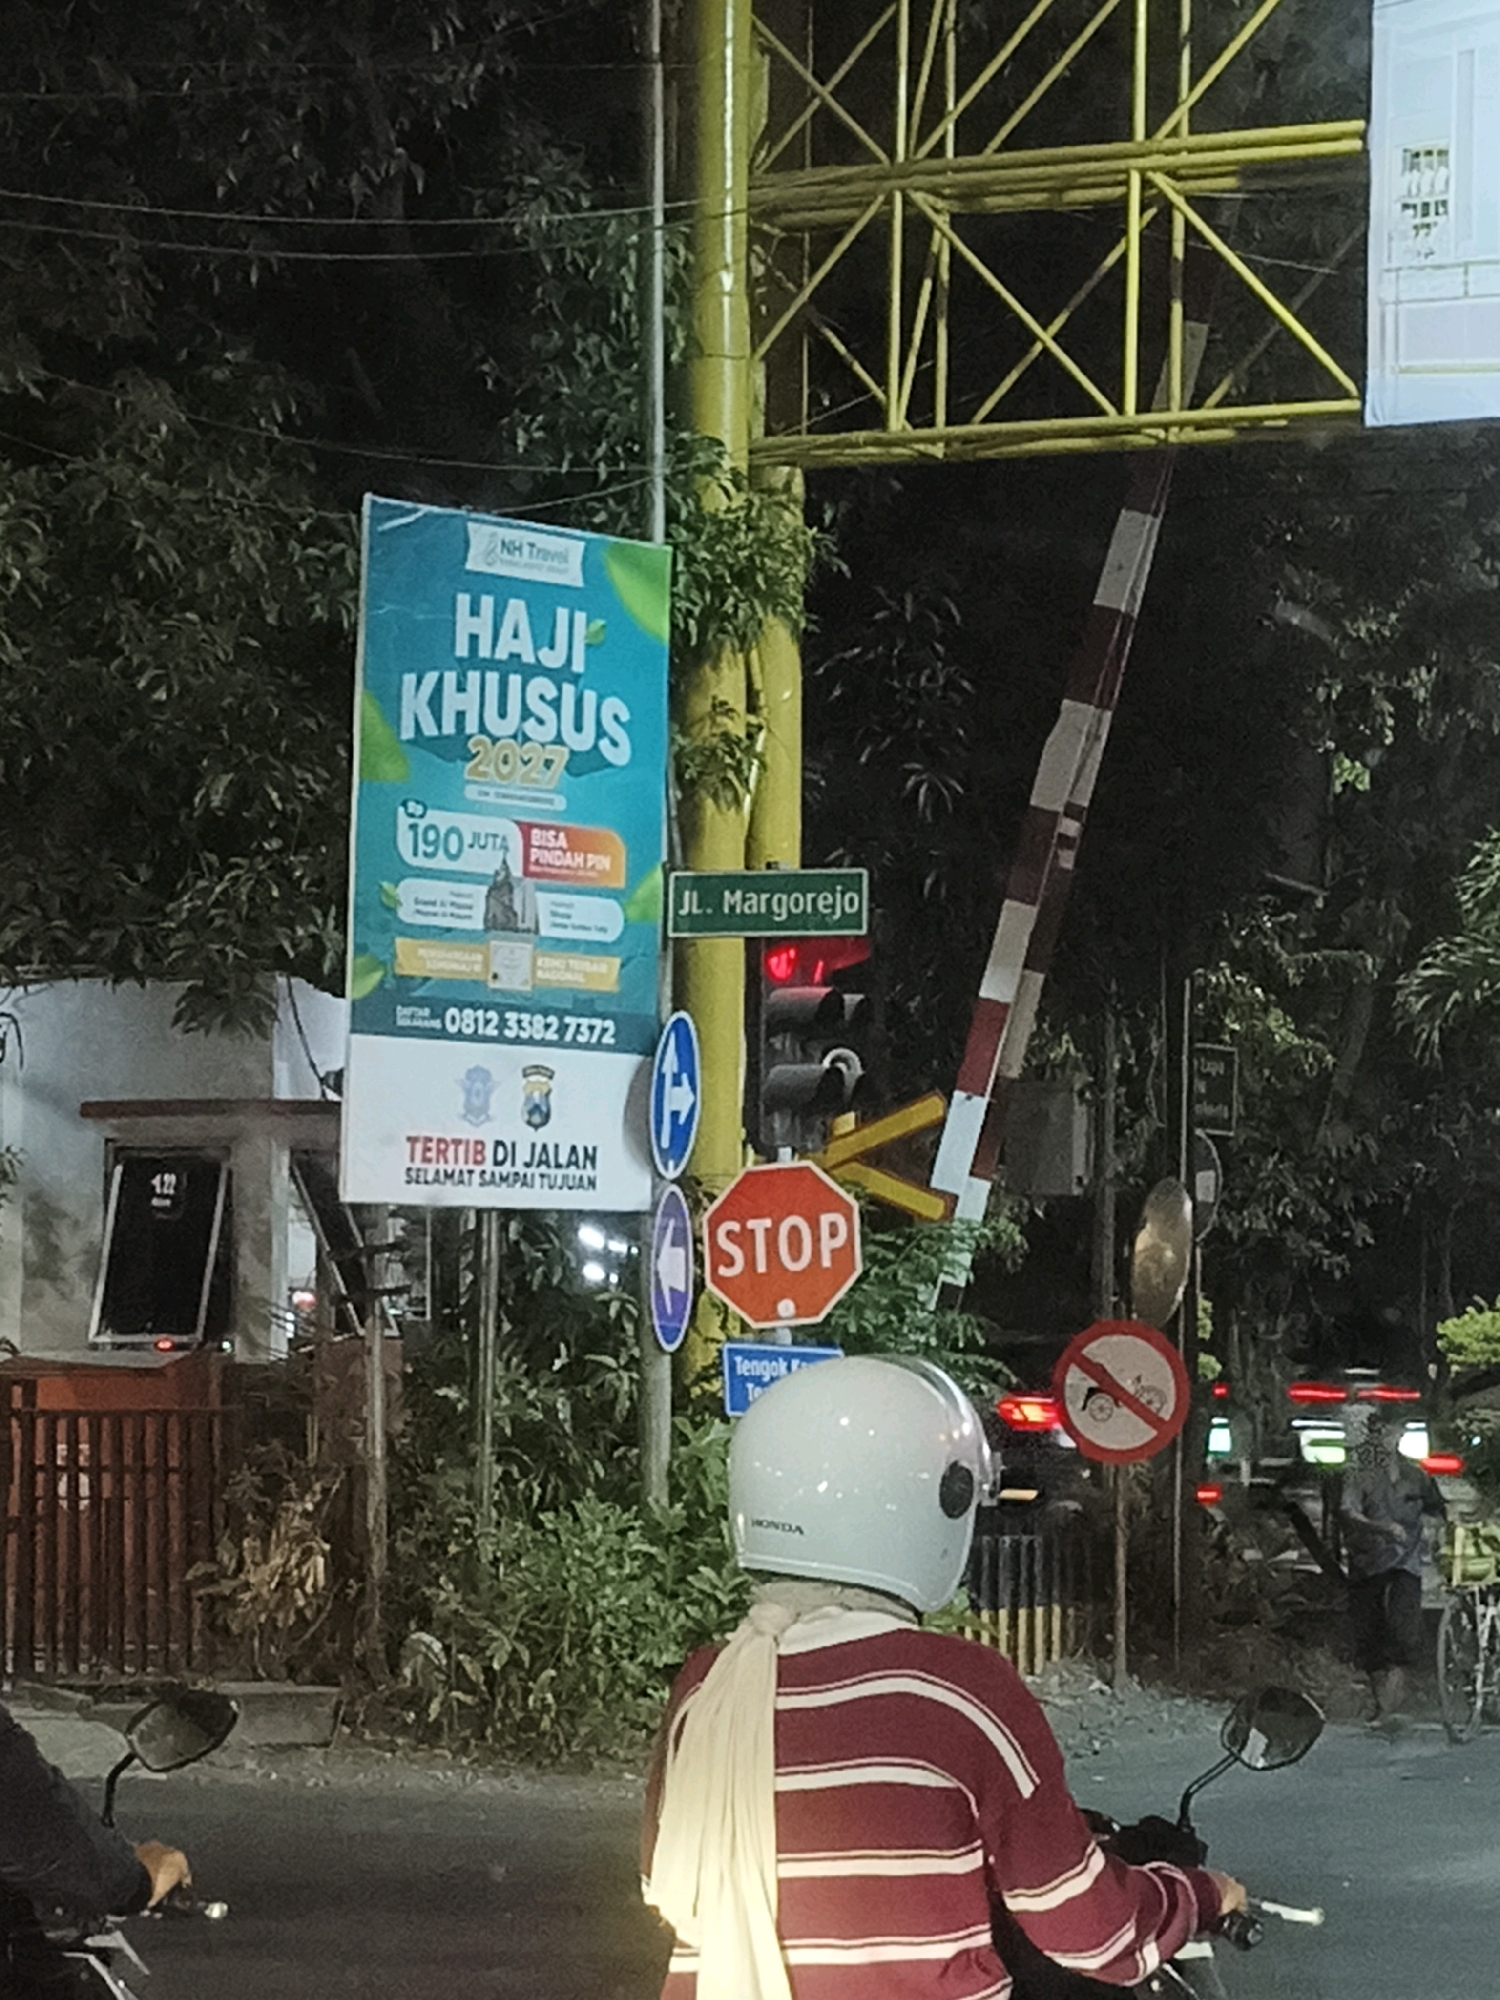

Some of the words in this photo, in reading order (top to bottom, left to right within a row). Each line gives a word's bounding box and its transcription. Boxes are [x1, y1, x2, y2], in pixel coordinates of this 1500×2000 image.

[500, 539, 523, 558] NH
[526, 541, 570, 564] Travel
[455, 592, 587, 674] HAJI
[400, 670, 631, 766] KHUSUS
[464, 735, 570, 789] 2027
[408, 823, 464, 862] 190
[467, 832, 509, 852] JUTA
[530, 827, 569, 850] BISA
[529, 847, 584, 869] PINDAH
[586, 853, 611, 872] PIN
[678, 890, 713, 915] JL.
[723, 885, 860, 921] Margorejo
[445, 1007, 499, 1036] 0812
[503, 1011, 559, 1040] 3382
[563, 1016, 616, 1044] 7372
[406, 1136, 487, 1166] TERTIB
[493, 1139, 516, 1168] DI
[523, 1142, 597, 1171] JALAN
[405, 1167, 475, 1186] SELAMAT
[478, 1170, 535, 1189] SAMPAI
[539, 1173, 597, 1191] TUJUAN
[716, 1212, 848, 1278] STOP
[734, 1355, 789, 1382] Tengok
[751, 1518, 804, 1535] HONDA
